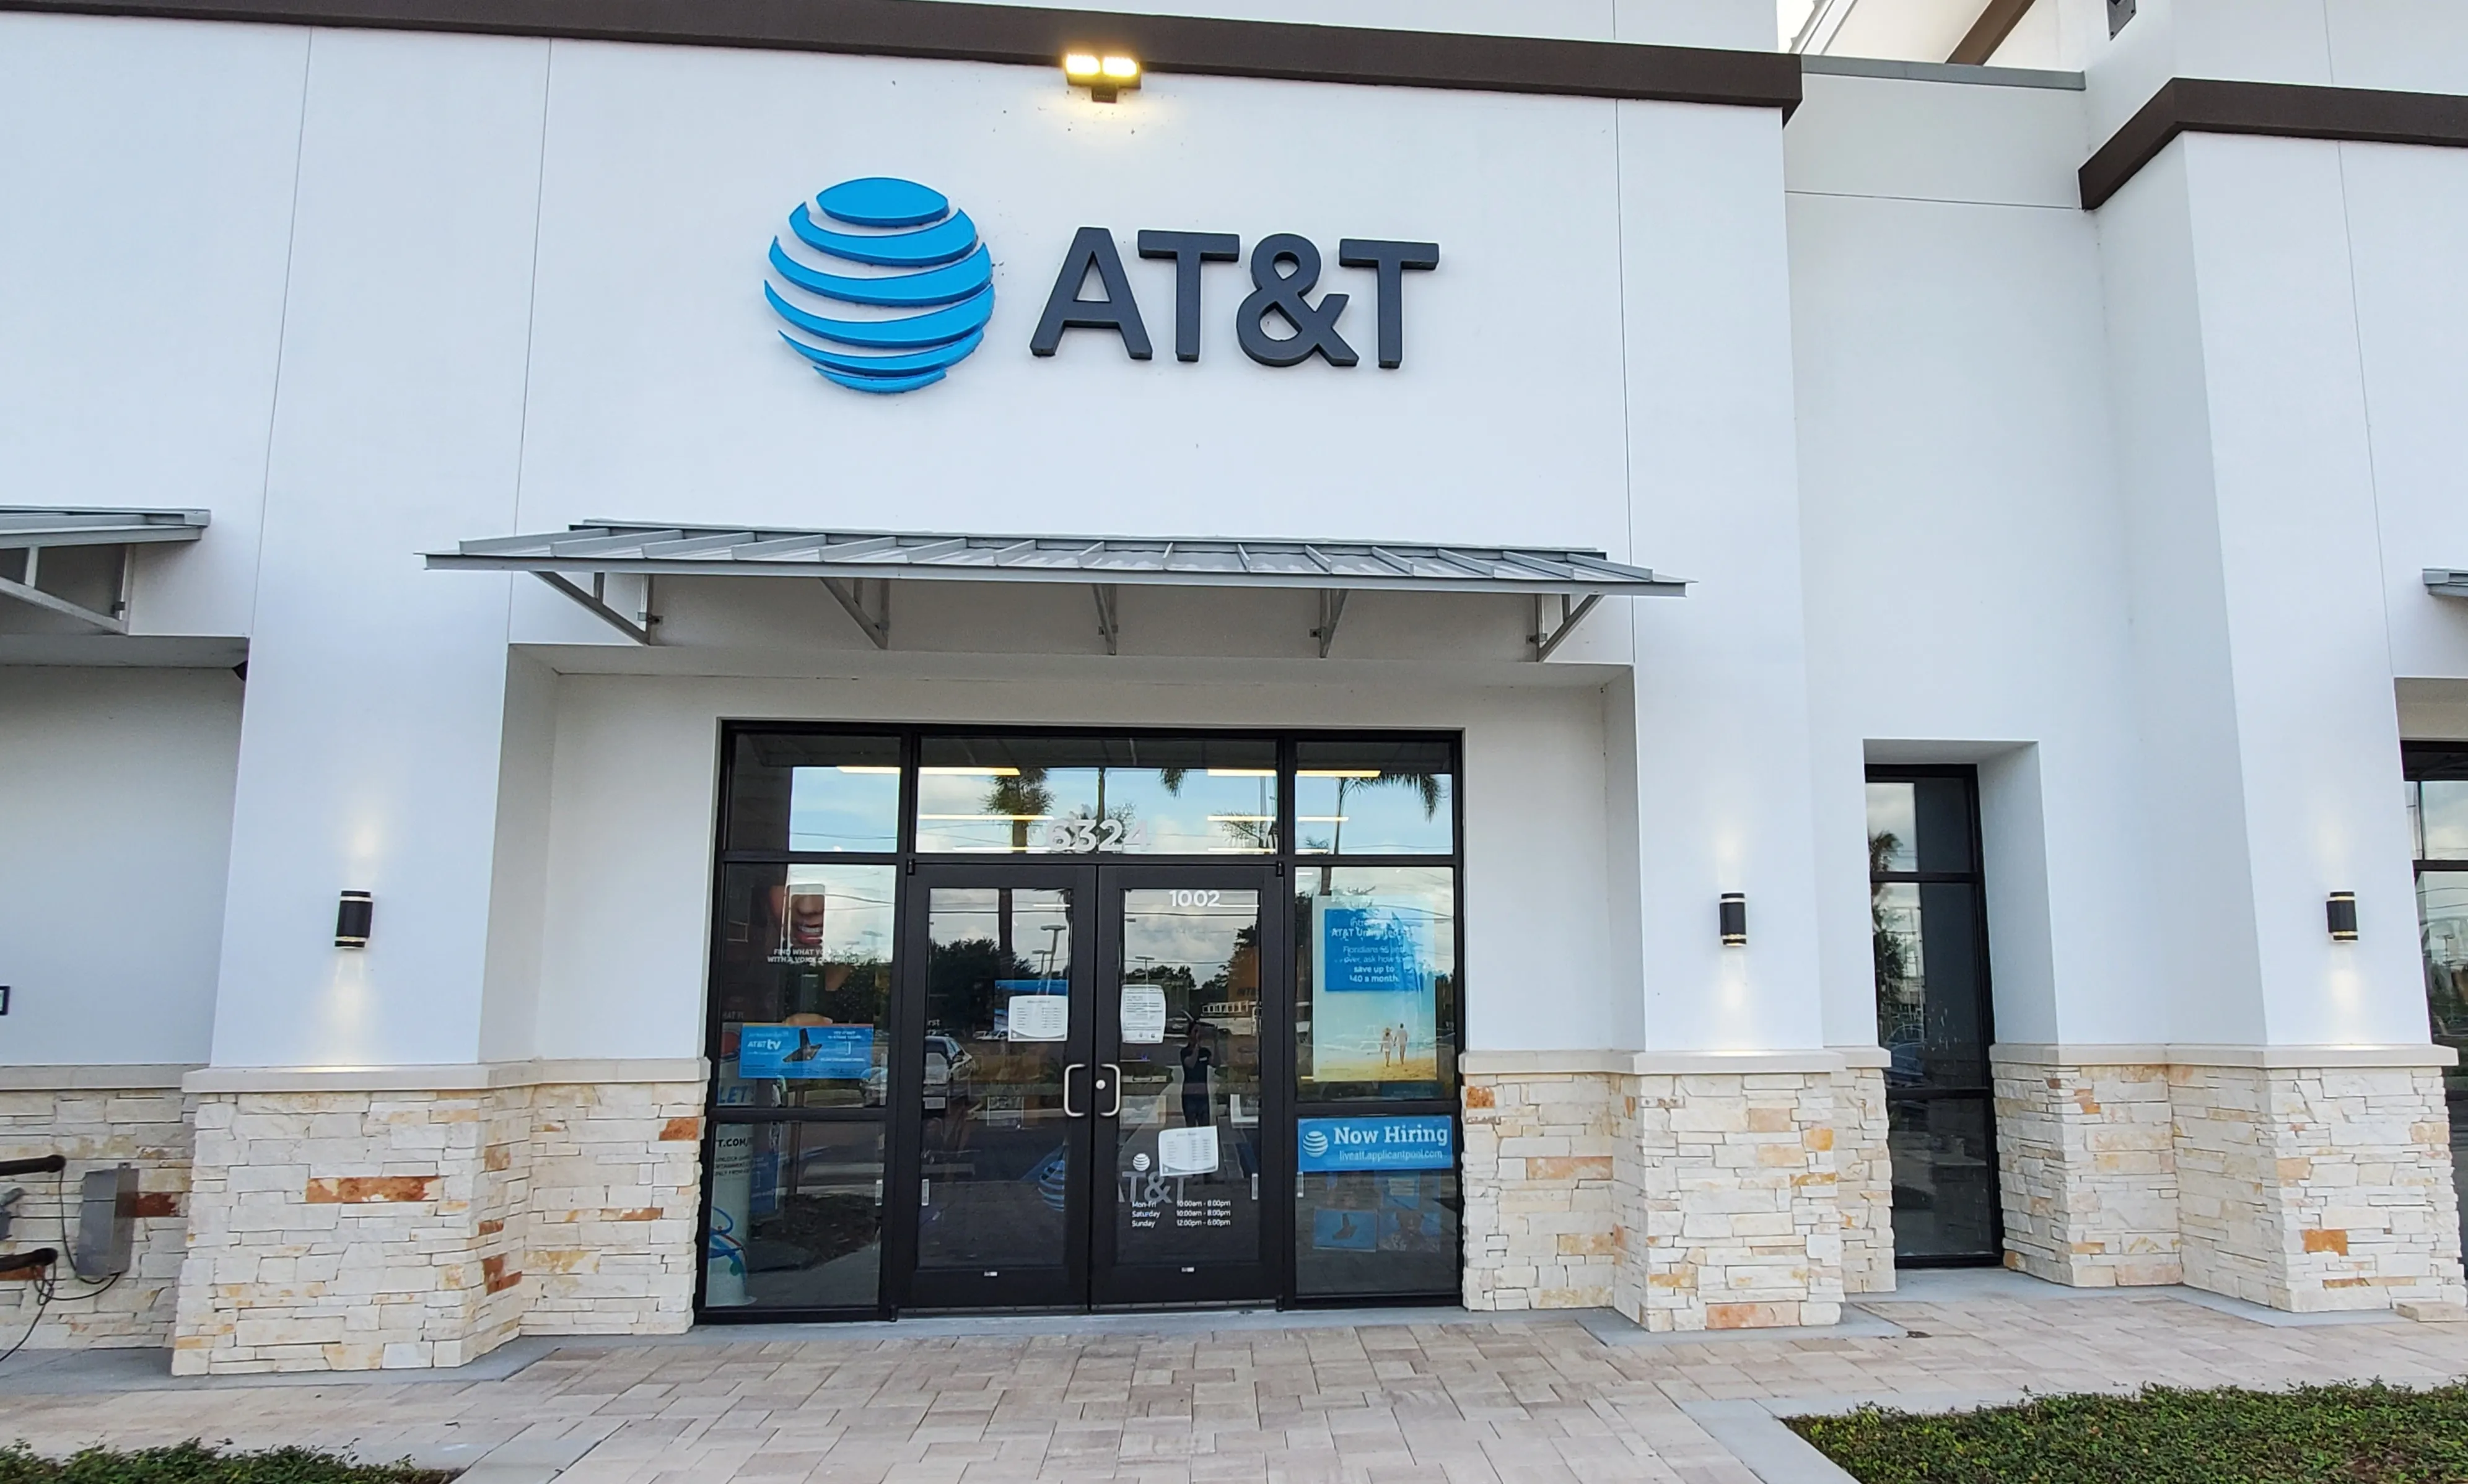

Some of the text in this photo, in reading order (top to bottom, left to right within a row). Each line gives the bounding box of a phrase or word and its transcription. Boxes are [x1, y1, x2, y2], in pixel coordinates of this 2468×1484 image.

[1030, 226, 1439, 369] AT&T
[1046, 818, 1149, 852] 6324
[1169, 889, 1221, 907] 1002
[1373, 966, 1384, 974] up
[1333, 1124, 1448, 1146] Now Hiring
[1132, 1210, 1161, 1218] Saturday
[1132, 1220, 1156, 1228] Sunday
